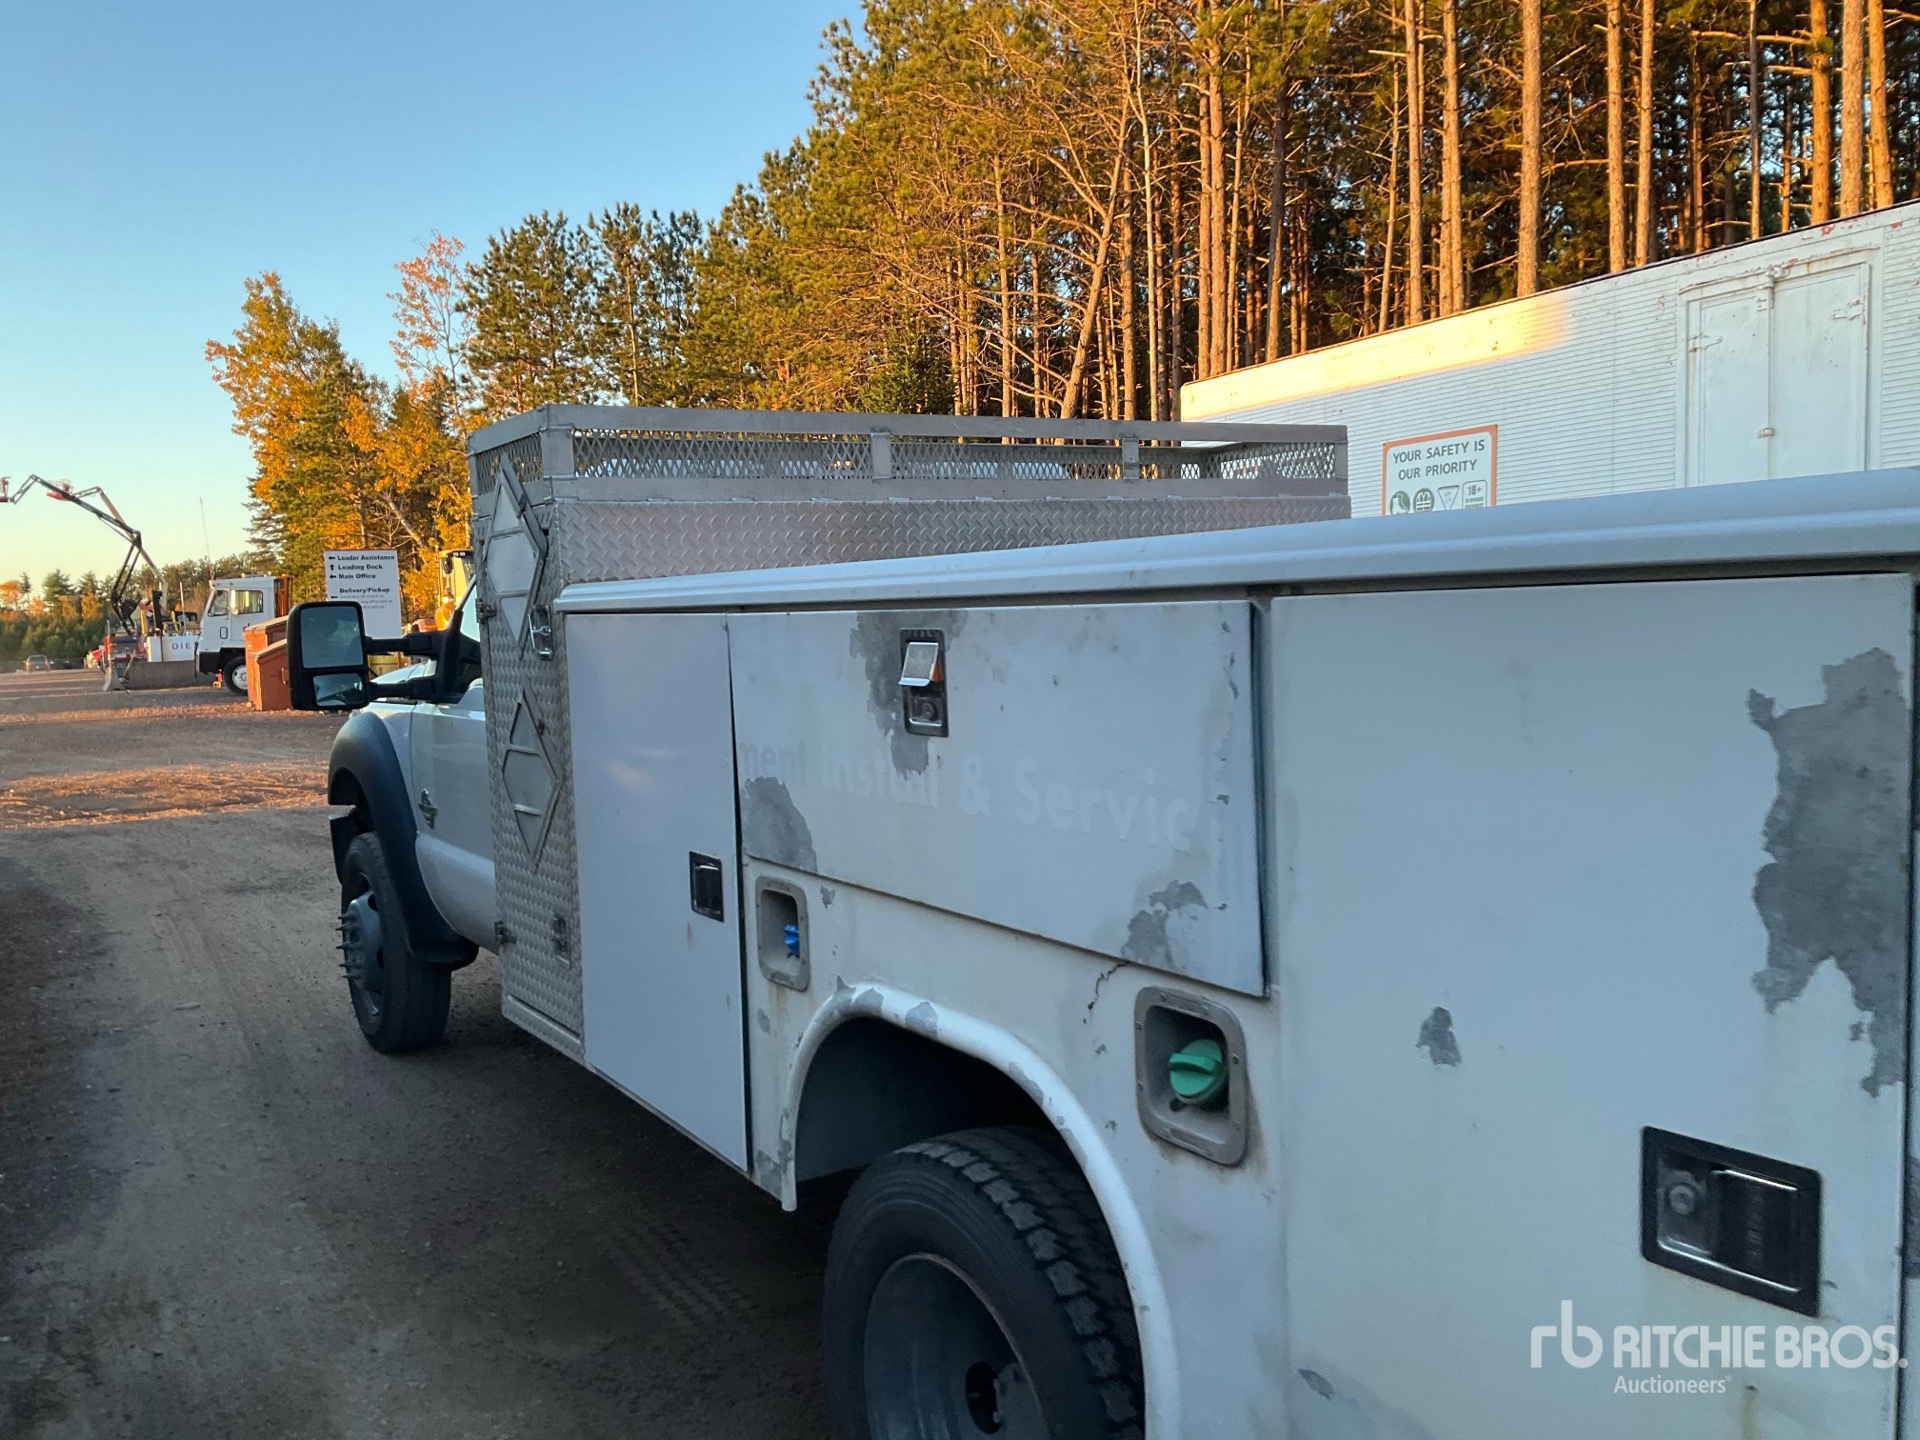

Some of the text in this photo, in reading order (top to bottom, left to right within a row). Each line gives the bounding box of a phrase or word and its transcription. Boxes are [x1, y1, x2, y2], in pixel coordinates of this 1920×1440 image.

[1393, 439, 1485, 464] YOUR SAFETY IS
[1398, 459, 1477, 480] OUR PRIORITY
[1467, 484, 1482, 495] 18+
